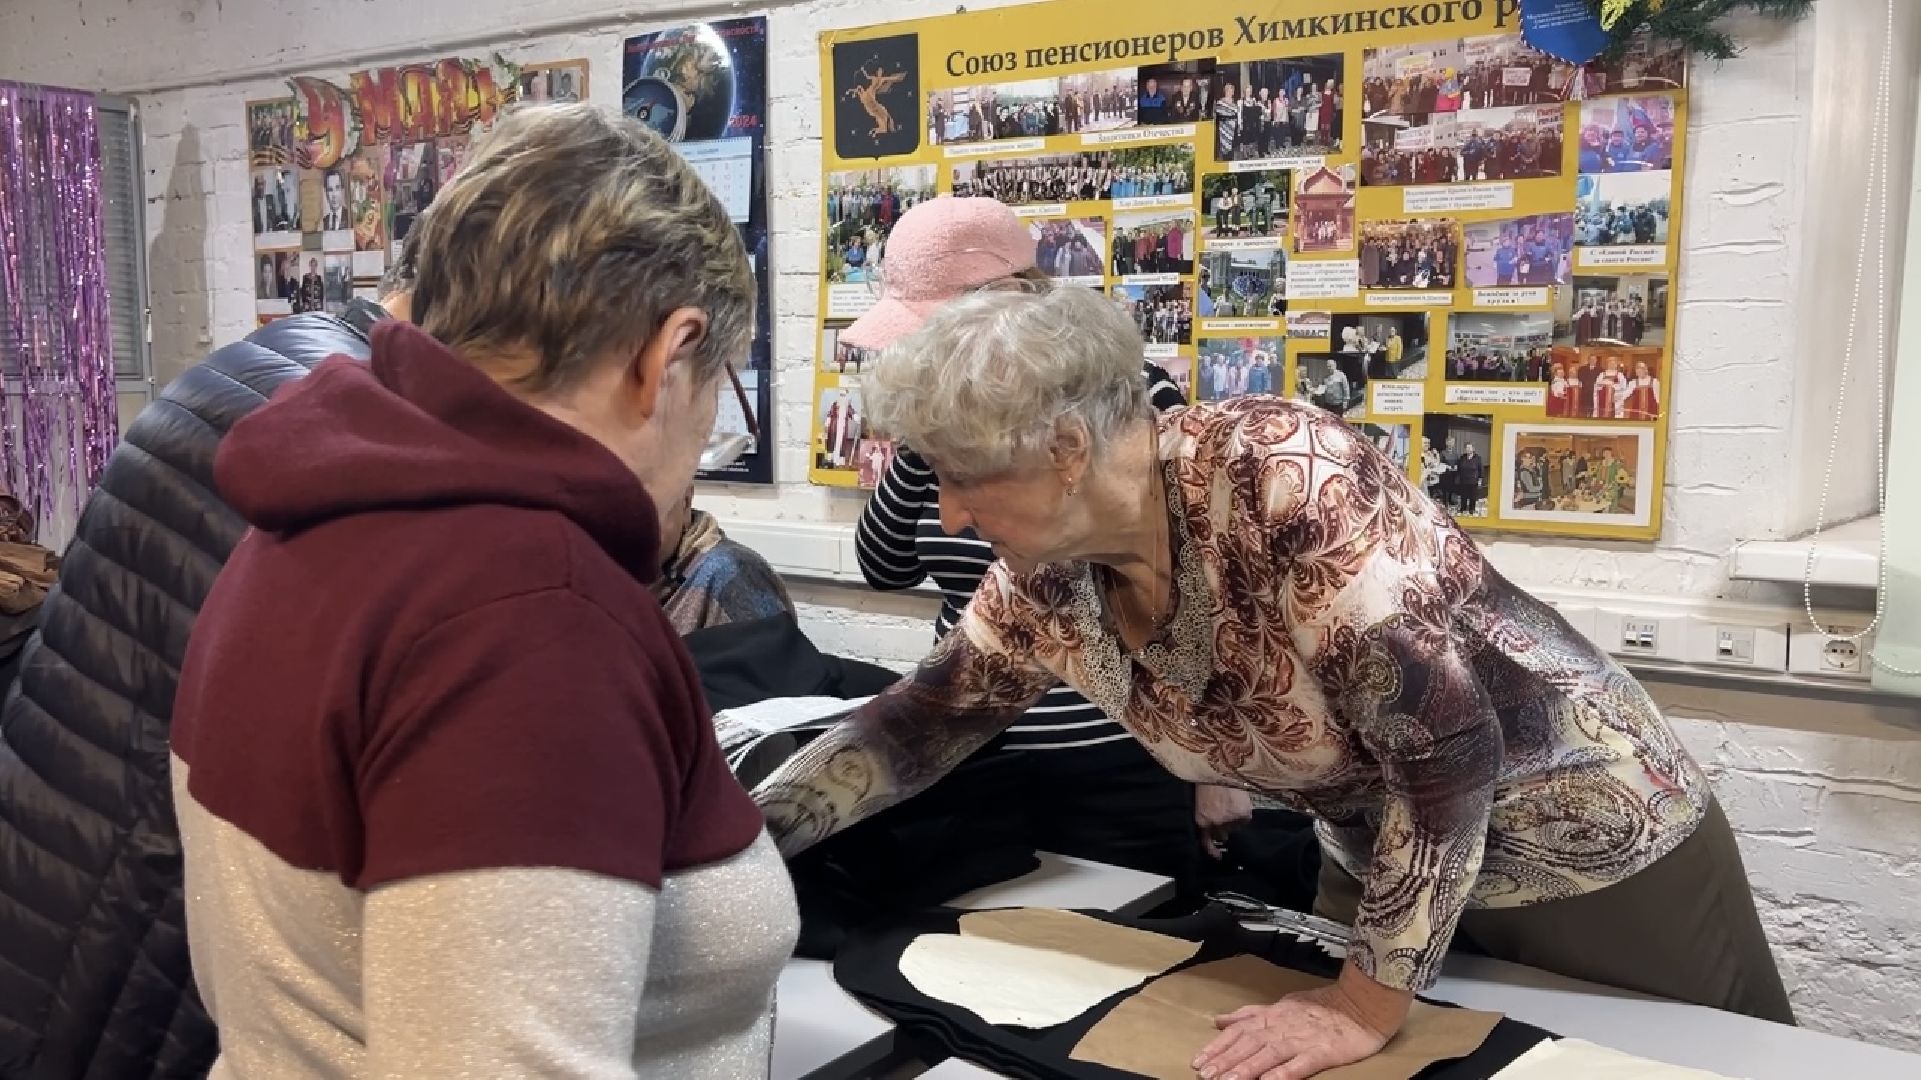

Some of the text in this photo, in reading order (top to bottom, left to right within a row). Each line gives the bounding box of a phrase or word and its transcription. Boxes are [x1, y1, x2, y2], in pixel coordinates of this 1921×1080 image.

[946, 50, 1018, 77] Союз
[1025, 27, 1225, 69] пенсионеров
[1233, 0, 1483, 46] Химкинского
[728, 114, 759, 129] 2024
